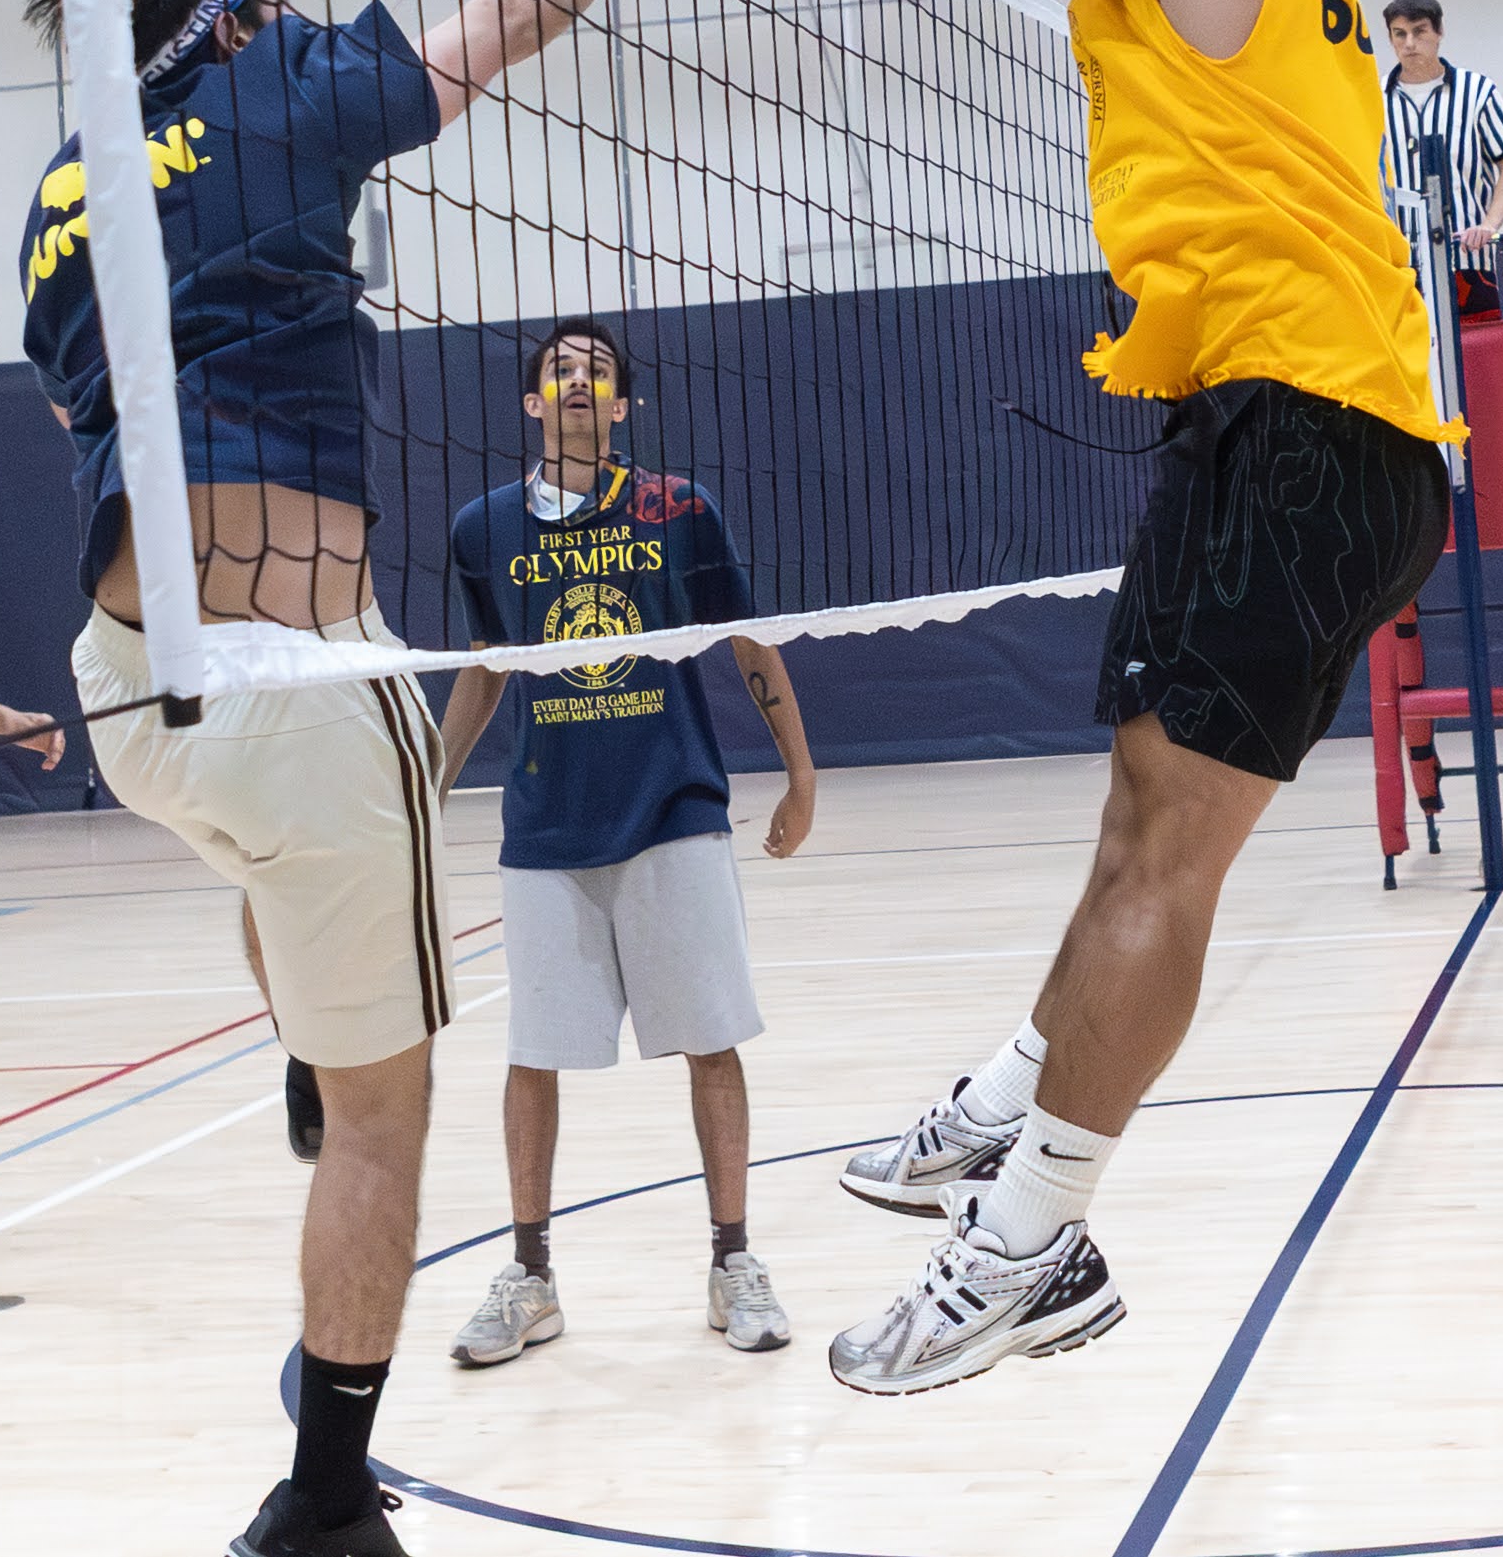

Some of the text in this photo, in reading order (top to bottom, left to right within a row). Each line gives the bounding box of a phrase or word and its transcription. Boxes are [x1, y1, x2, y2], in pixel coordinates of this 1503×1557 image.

[539, 525, 632, 550] FIRST YEAR
[509, 541, 663, 585] OLYMPICS
[532, 689, 664, 714] EVERY DAY IS GAME DAY
[535, 714, 543, 724] A
[613, 702, 664, 718] TRADITION
